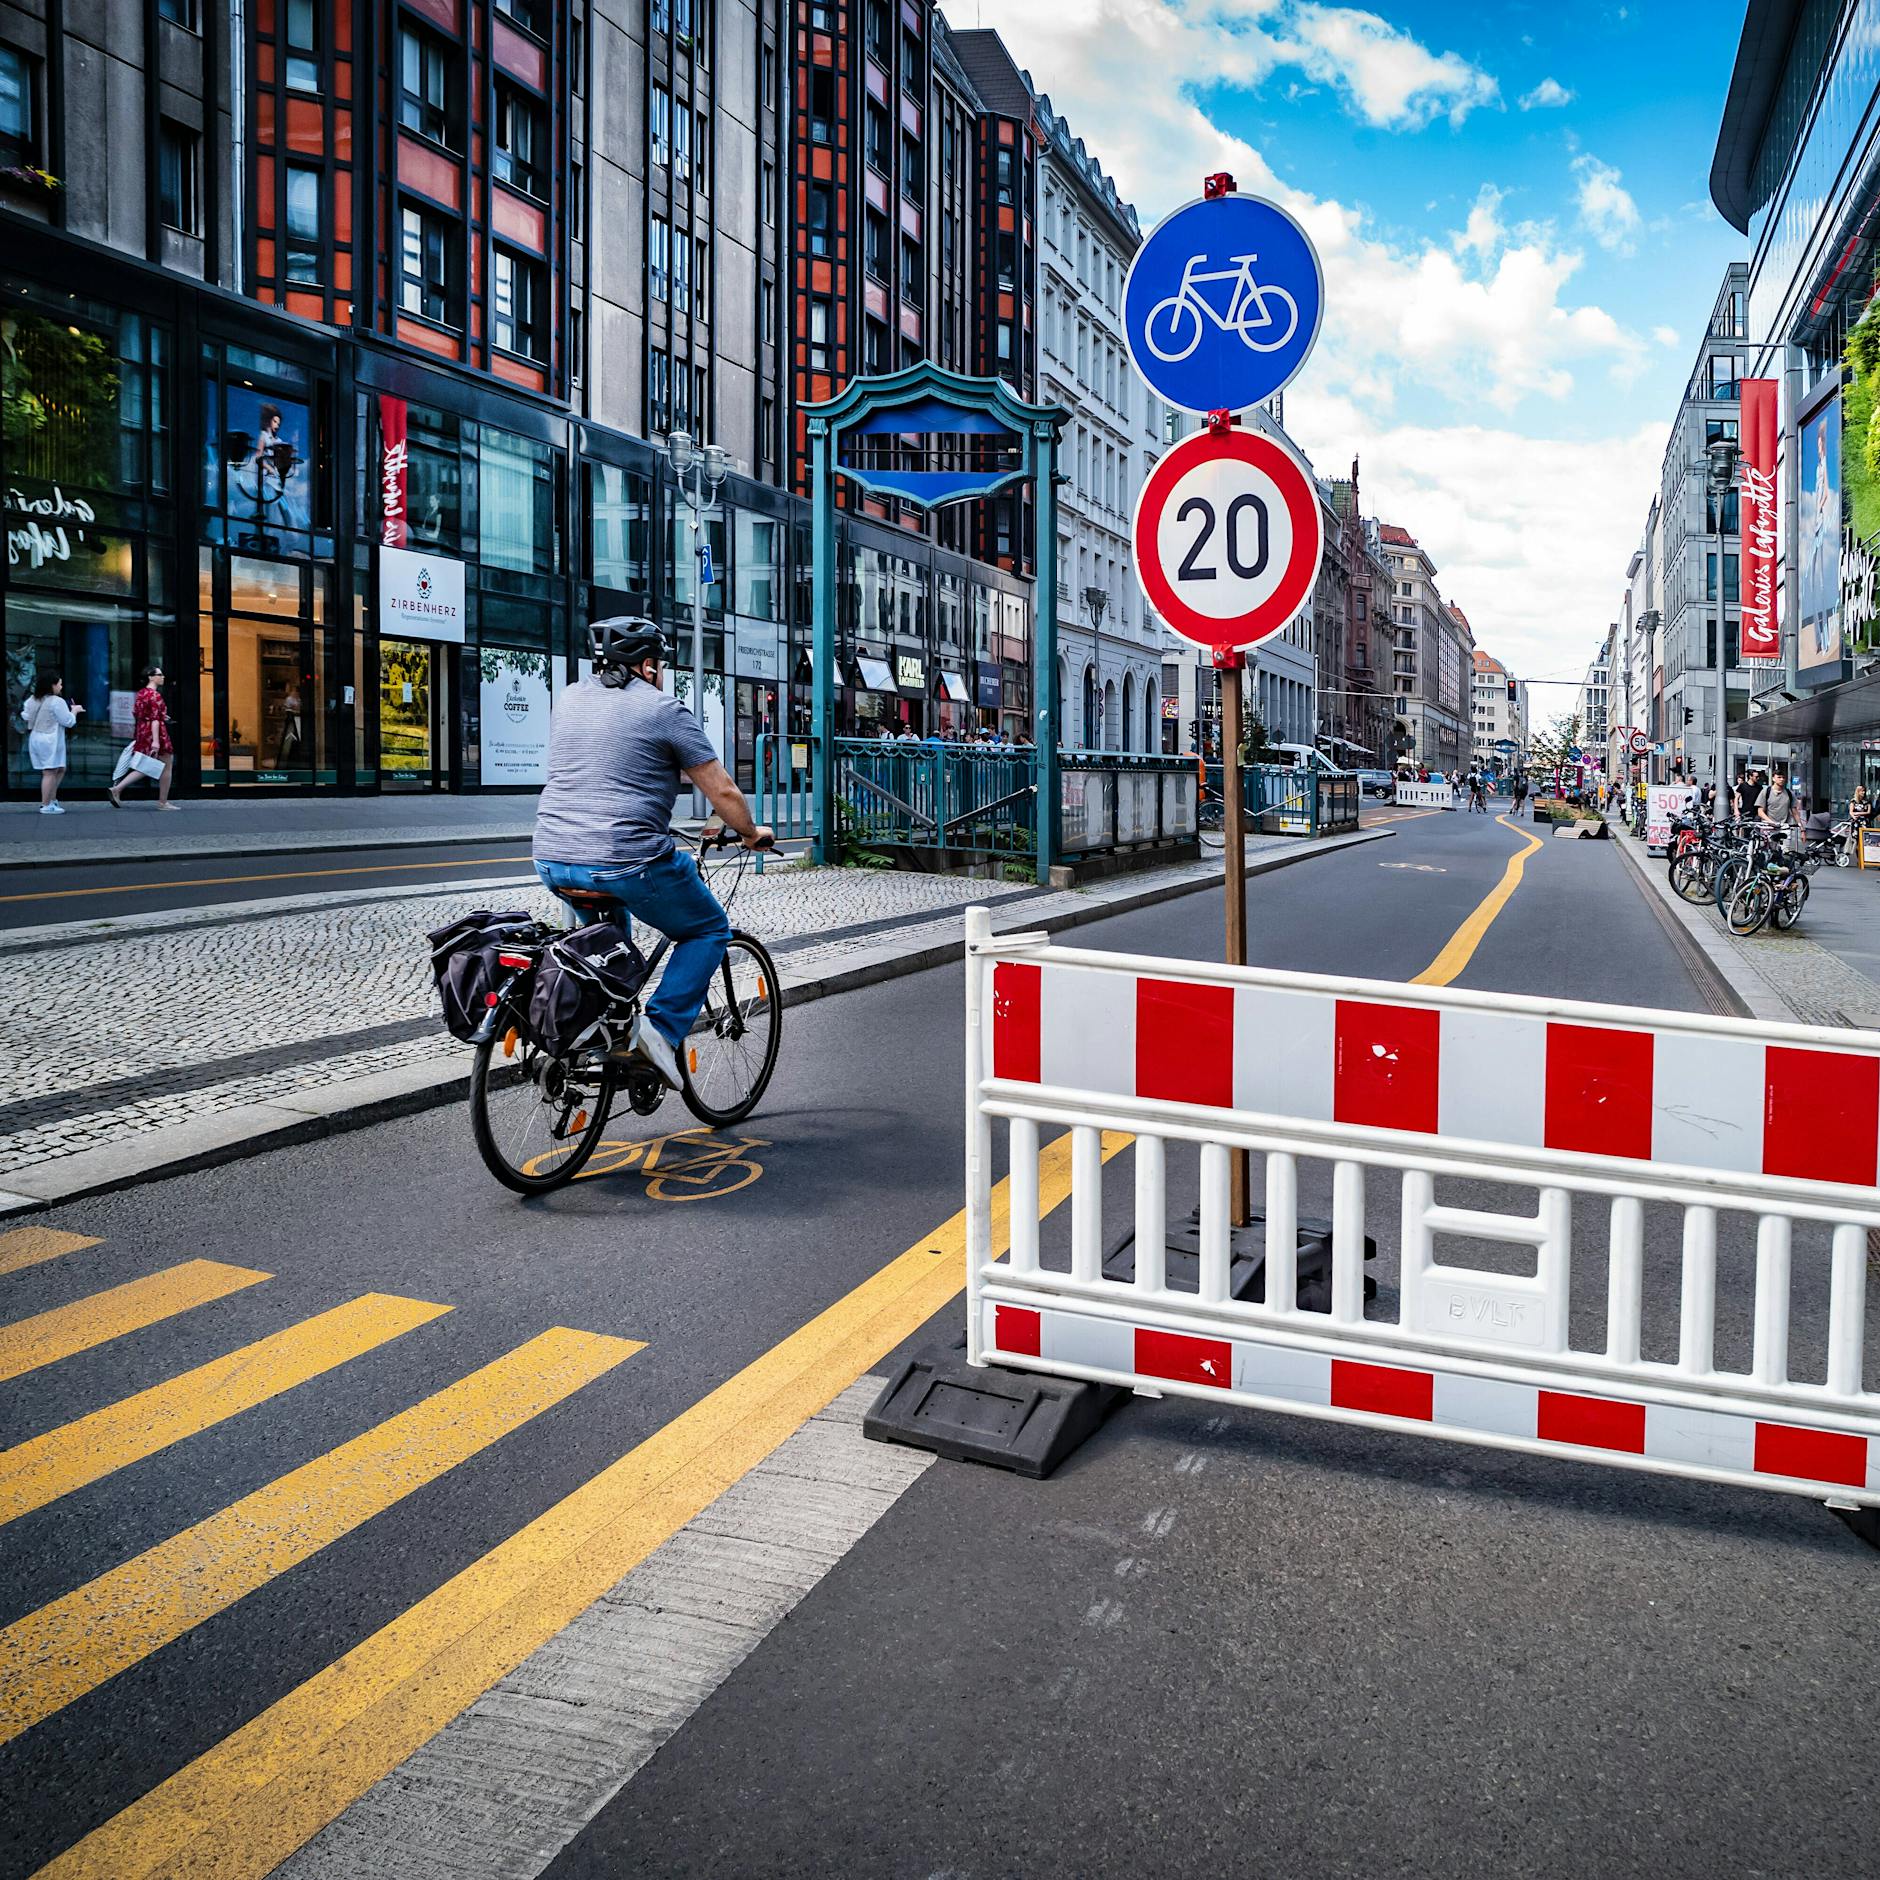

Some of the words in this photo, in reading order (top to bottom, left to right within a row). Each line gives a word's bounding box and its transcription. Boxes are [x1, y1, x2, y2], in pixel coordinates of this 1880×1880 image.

[1741, 465, 1778, 558] Lafayette
[1176, 493, 1269, 581] 20
[391, 598, 456, 617] ZIRBENHERZ
[1741, 564, 1779, 642] Galeries
[752, 660, 762, 670] 172
[898, 655, 925, 679] KARL
[504, 703, 529, 711] COFFEE
[1634, 737, 1646, 747] 50
